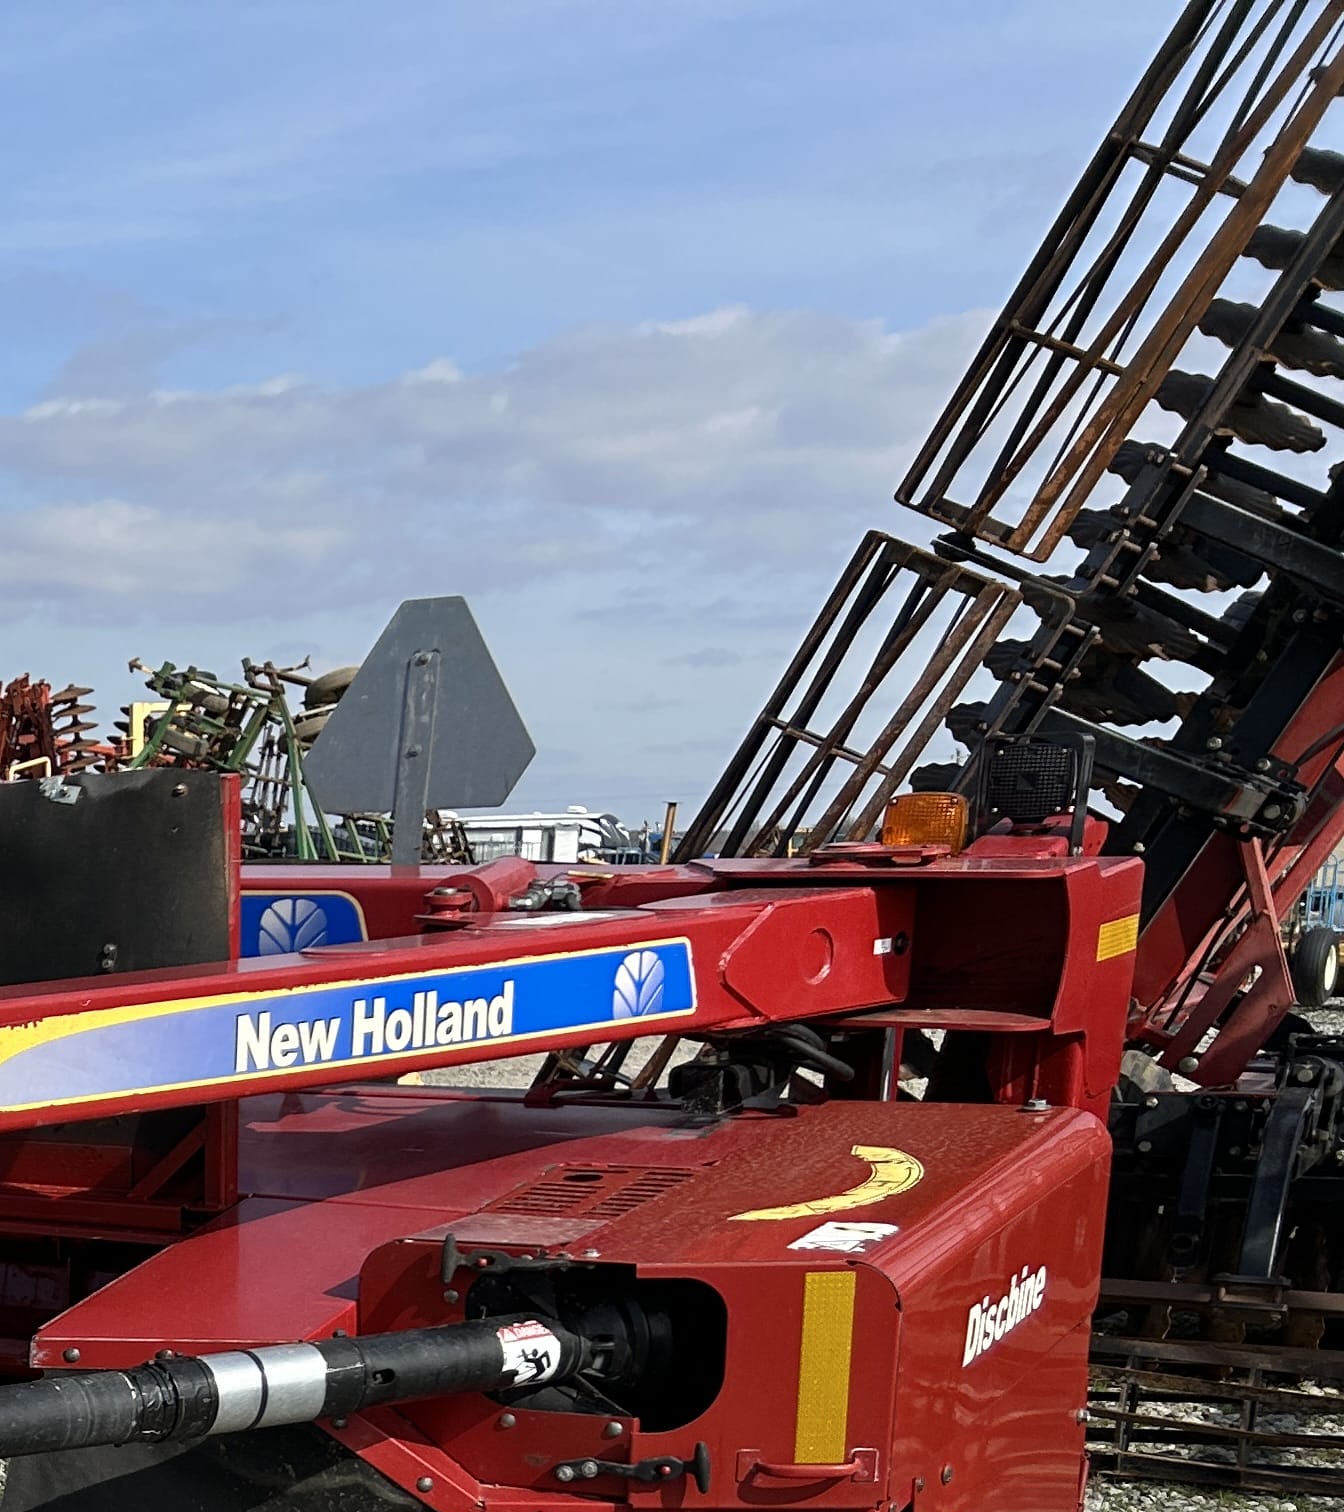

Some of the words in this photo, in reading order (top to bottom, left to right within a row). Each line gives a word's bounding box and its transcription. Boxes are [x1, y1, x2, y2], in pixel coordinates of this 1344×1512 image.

[235, 1012, 341, 1073] New
[351, 980, 514, 1056] Holland
[962, 1265, 1047, 1368] Discbine
